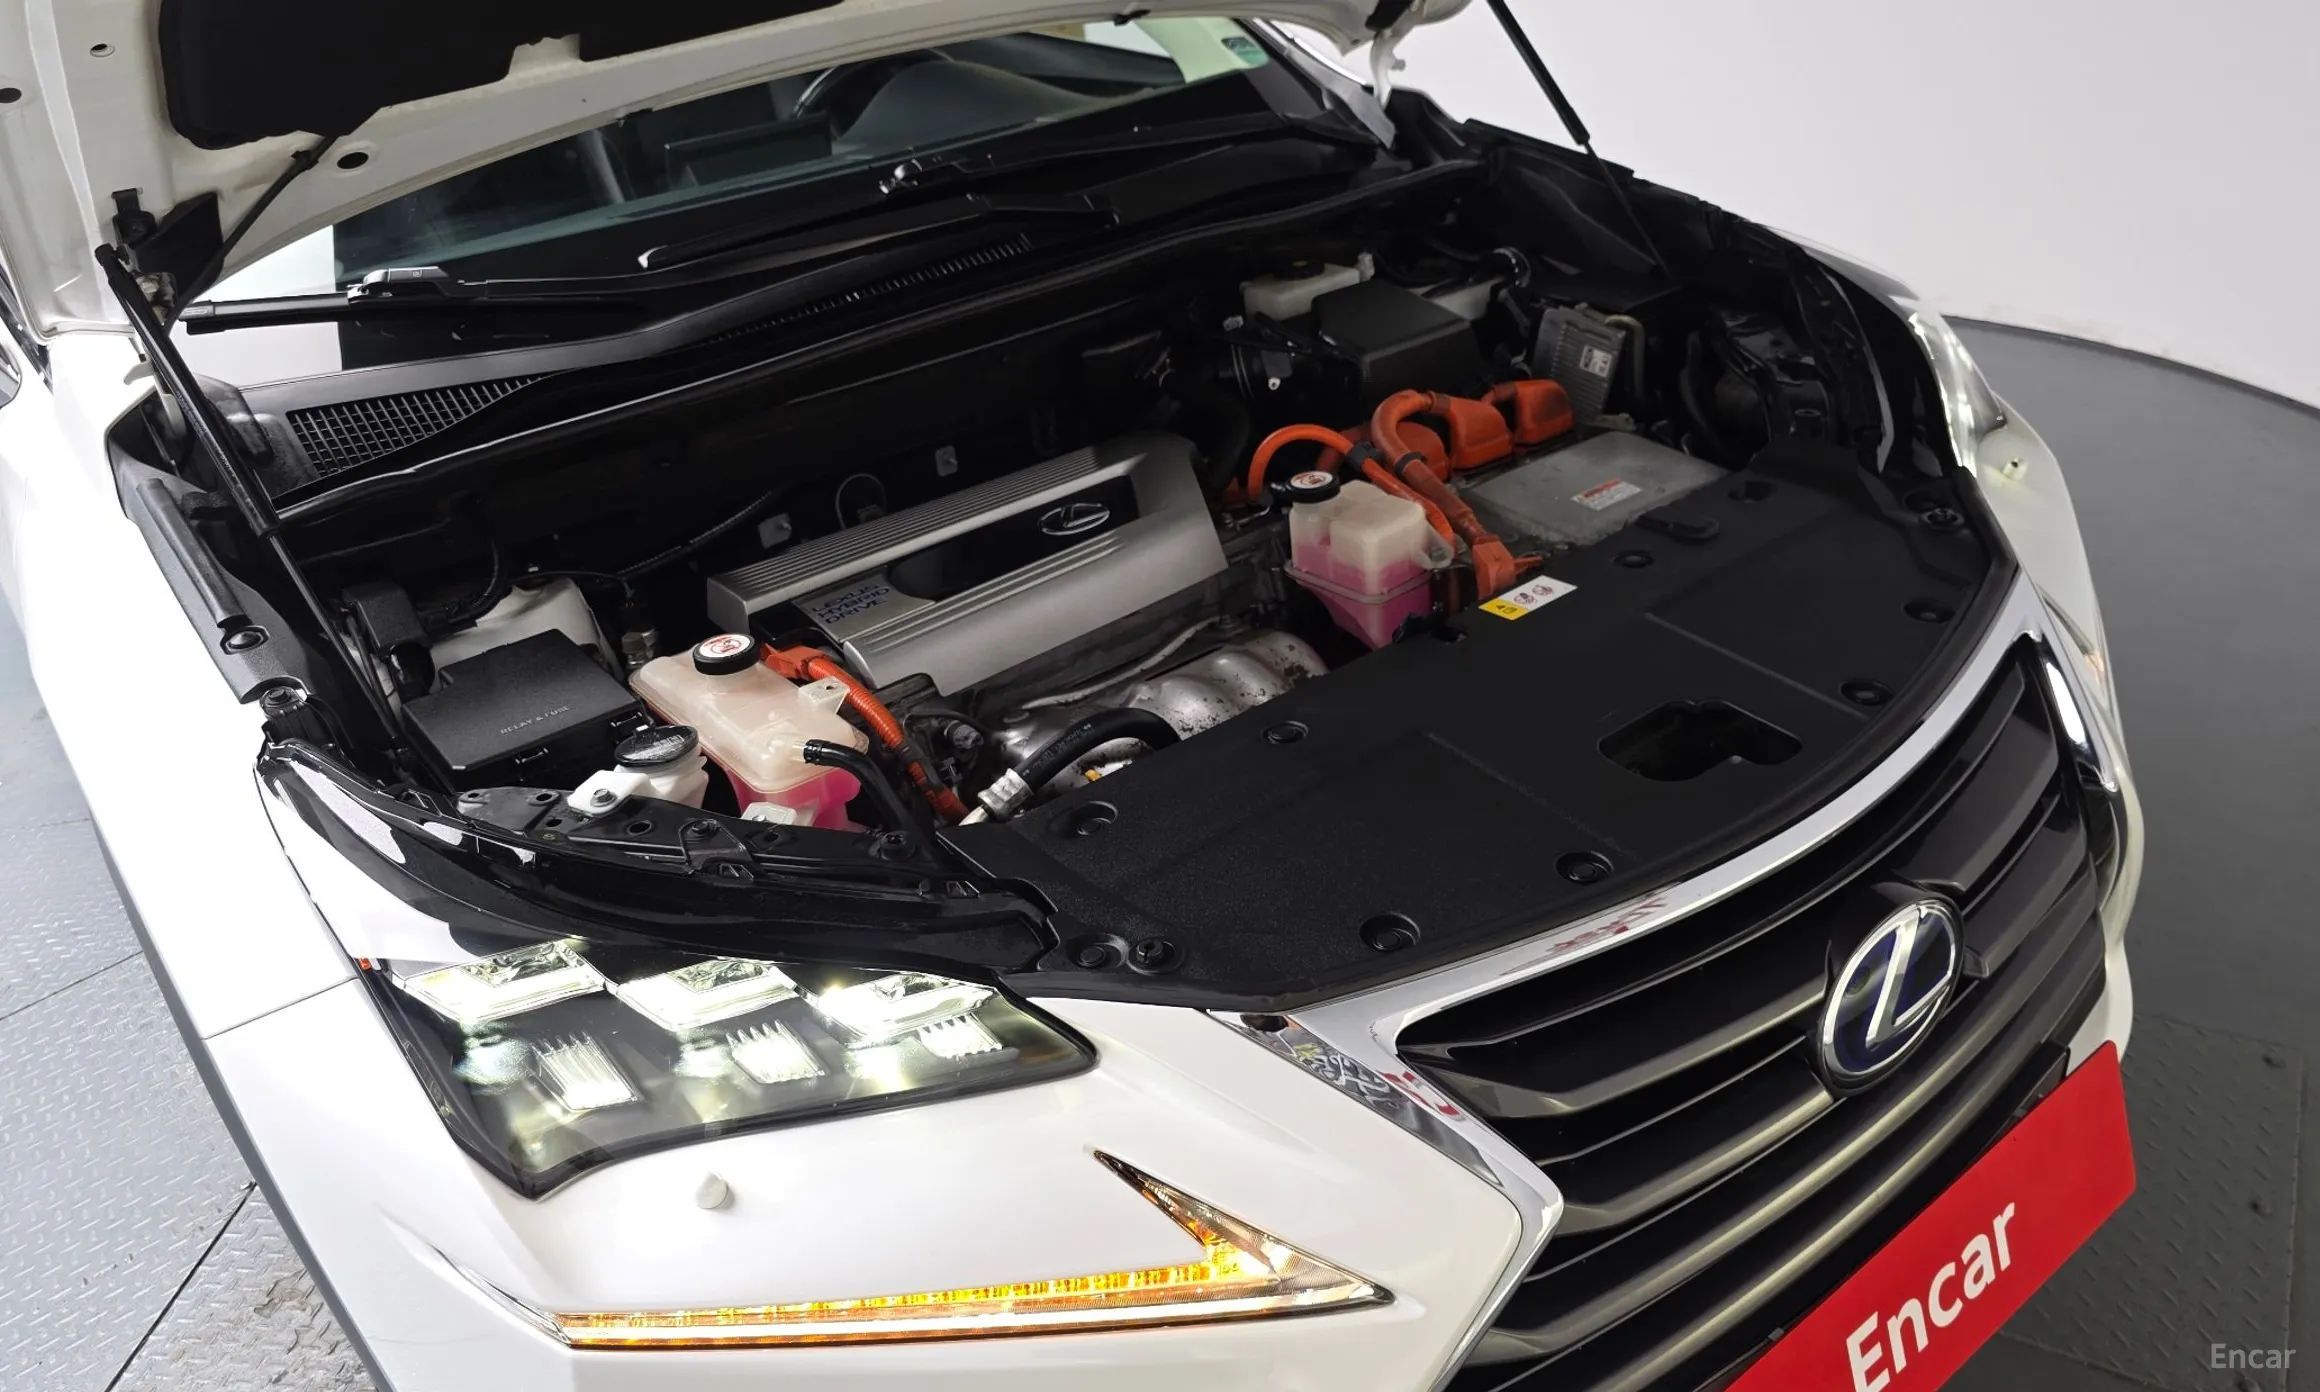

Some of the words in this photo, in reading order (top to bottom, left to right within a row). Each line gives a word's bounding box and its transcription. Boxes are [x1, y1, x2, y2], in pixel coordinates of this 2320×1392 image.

[812, 584, 881, 612] LEXUS
[818, 587, 890, 618] HYBRID
[826, 600, 888, 624] DRIVE
[500, 719, 532, 734] RELAY
[1845, 1202, 2016, 1392] Encar
